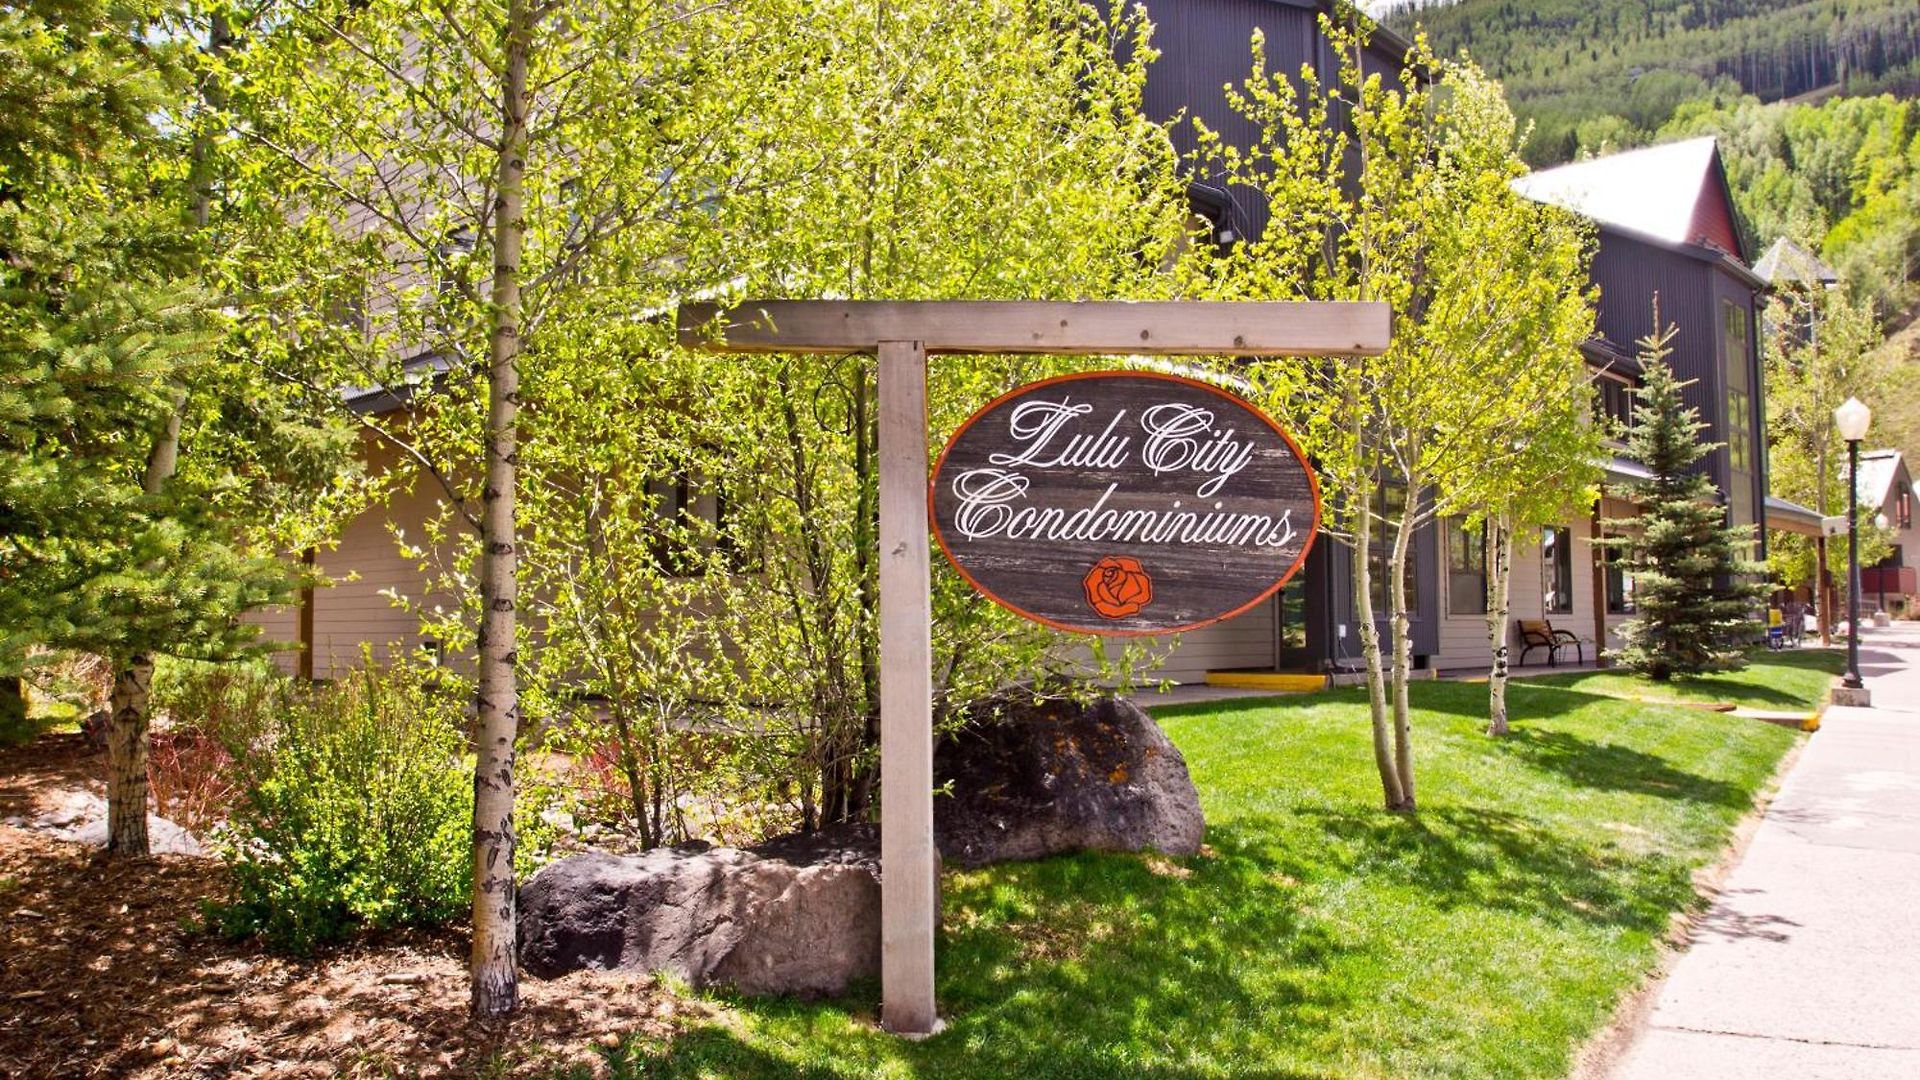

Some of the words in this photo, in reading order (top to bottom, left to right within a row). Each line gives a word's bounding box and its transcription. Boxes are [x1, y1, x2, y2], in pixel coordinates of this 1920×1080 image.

[989, 396, 1131, 468] Lulu
[1140, 402, 1255, 498] City
[952, 468, 1297, 547] Condominiums
